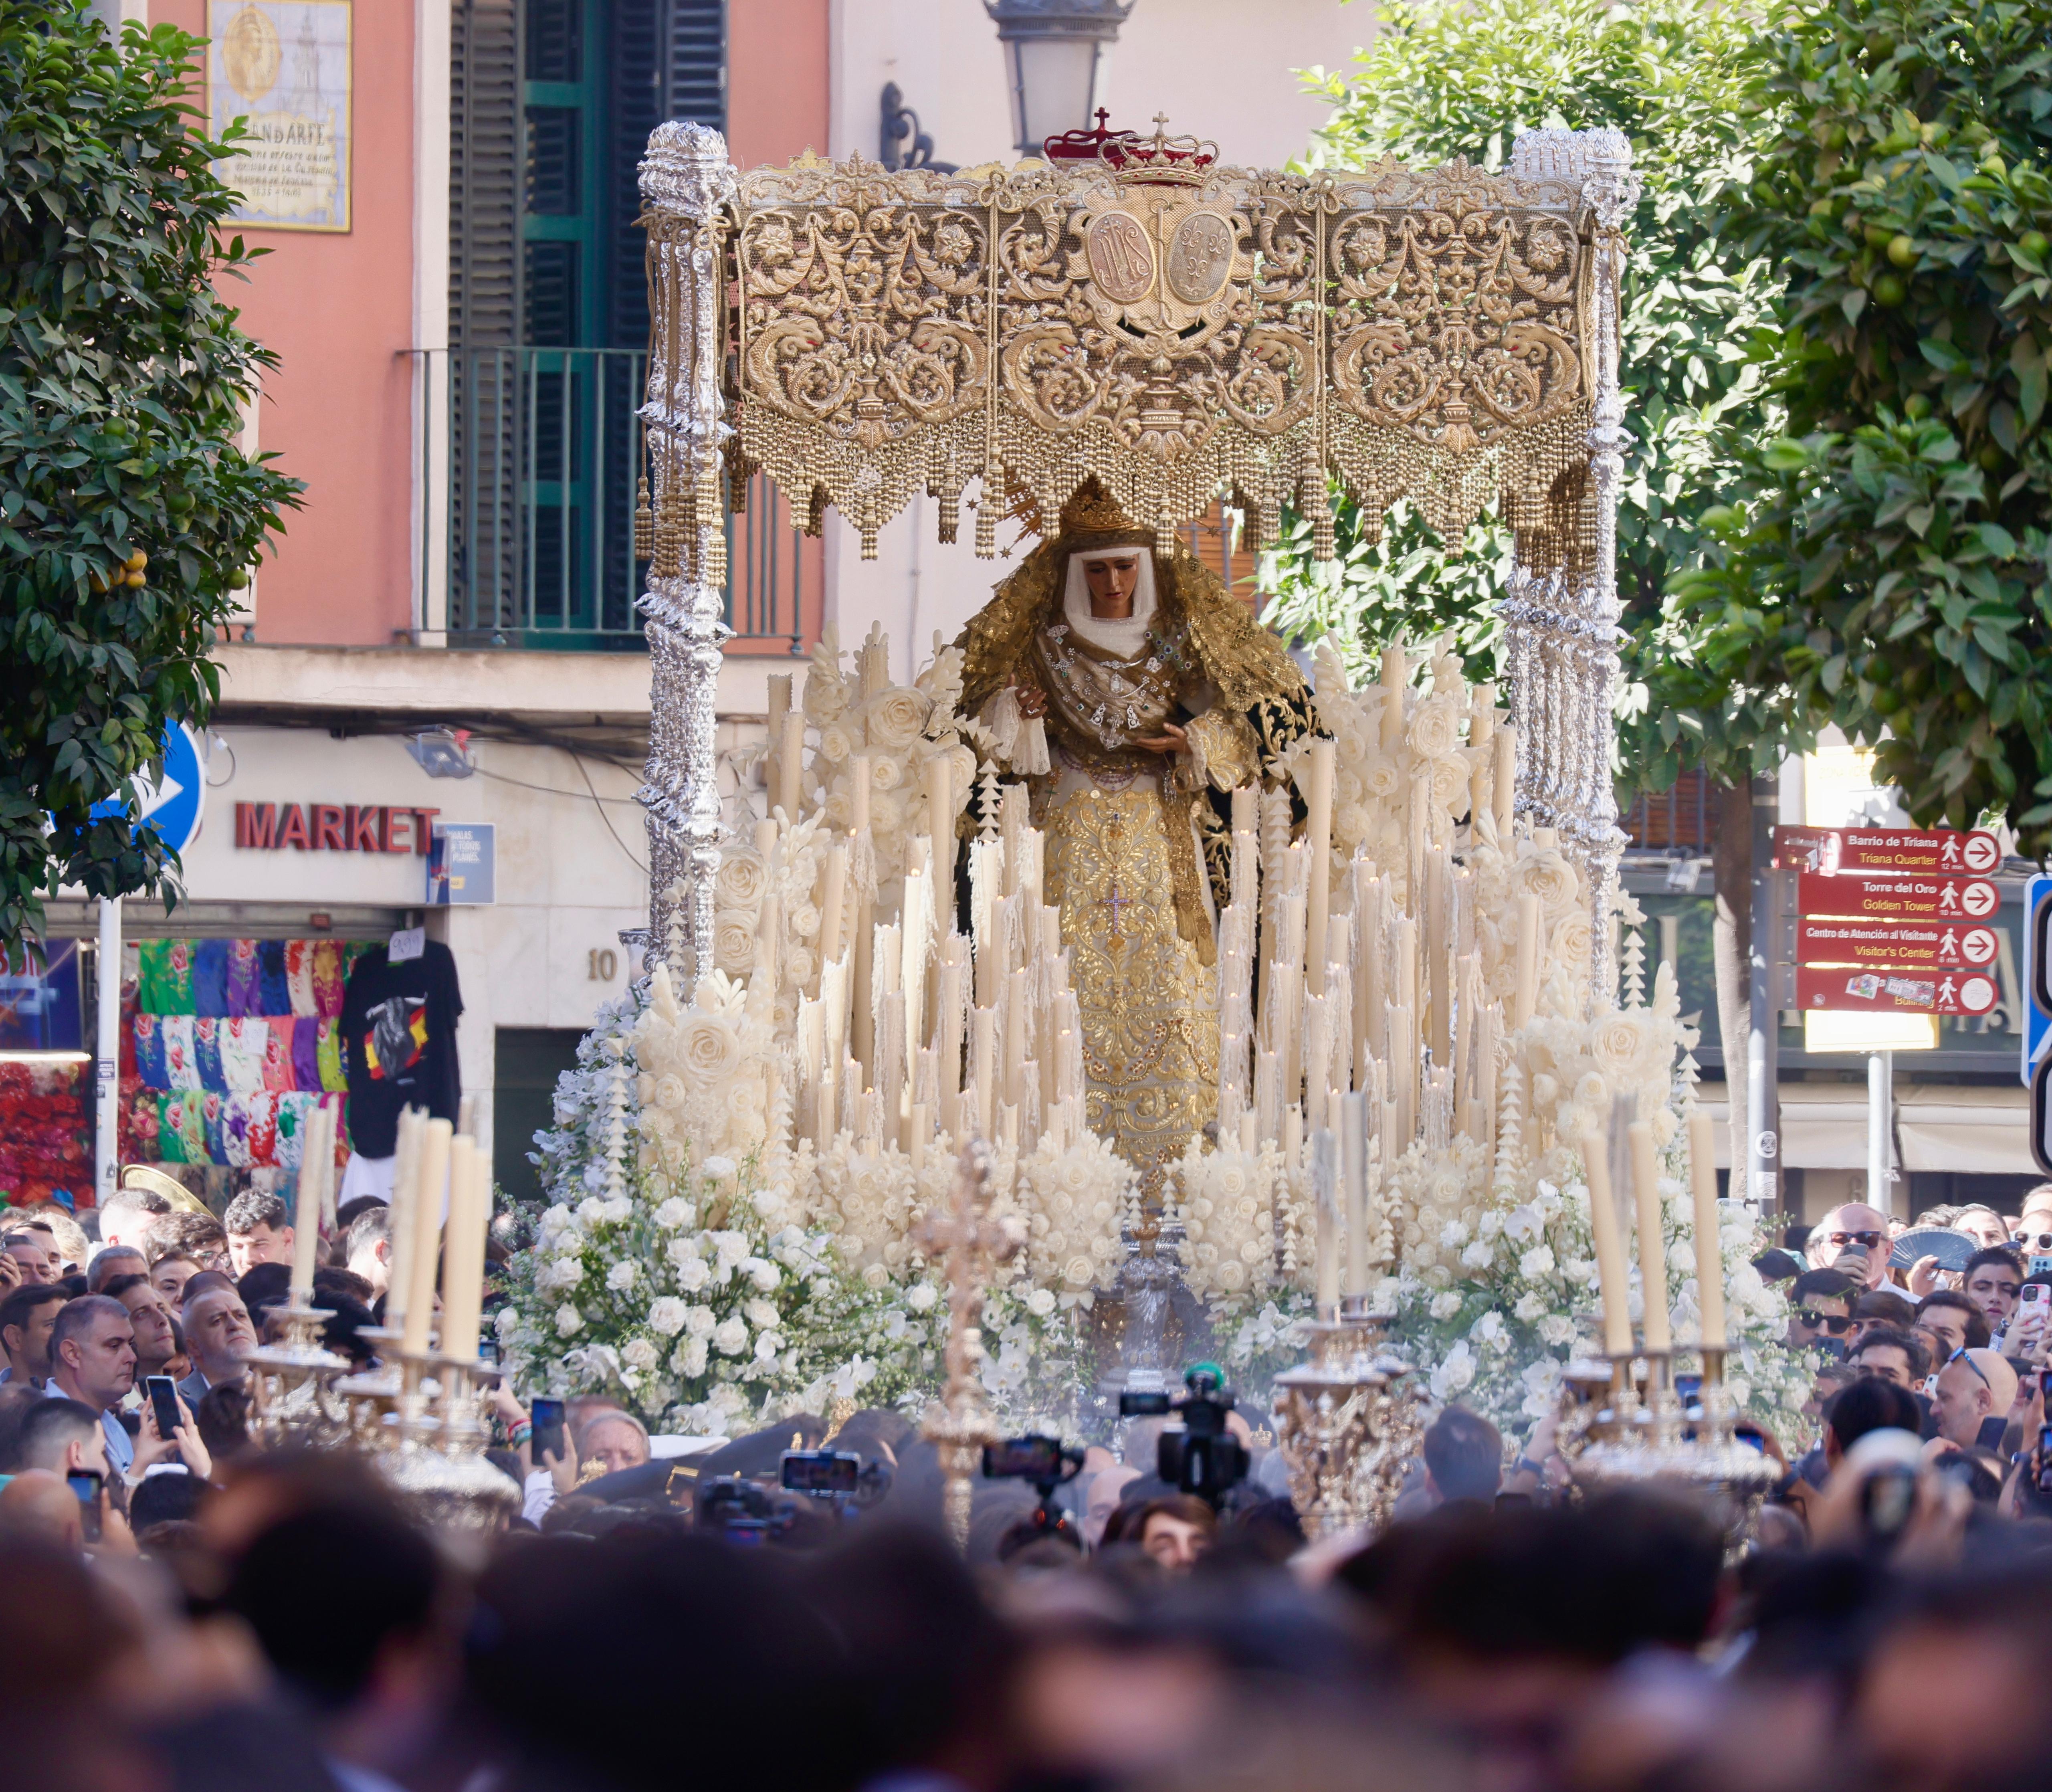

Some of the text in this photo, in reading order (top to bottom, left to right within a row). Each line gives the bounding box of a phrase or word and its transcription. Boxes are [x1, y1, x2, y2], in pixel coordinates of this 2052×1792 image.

[236, 802, 440, 855] MARKET
[1848, 835, 1938, 847] Barrio de Triana
[1860, 853, 1937, 865] Triana Quarter
[1863, 882, 1938, 893] Torre del Oro
[1863, 899, 1936, 911] Golden Tower
[1806, 927, 1938, 941] Centro de Atención al Visitante
[1854, 946, 1936, 958] Visitor's Center
[588, 948, 618, 981] 10
